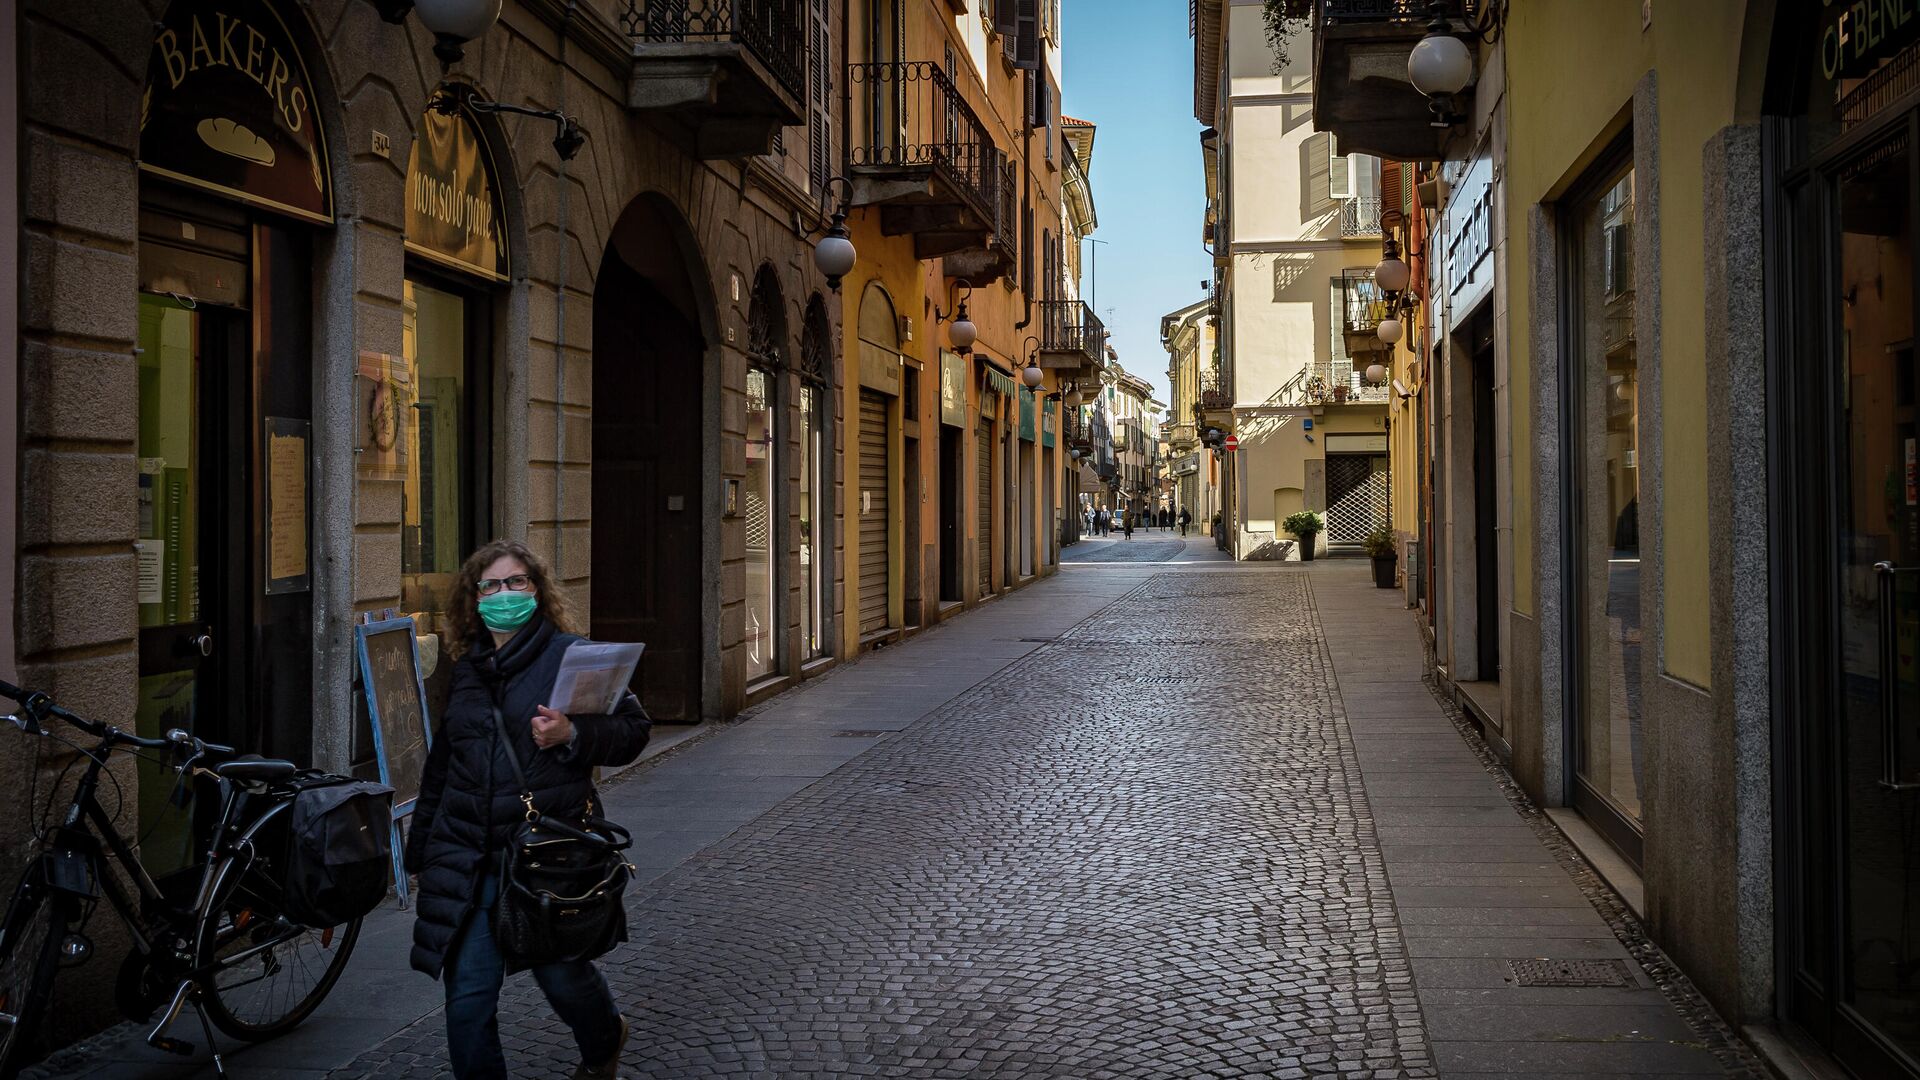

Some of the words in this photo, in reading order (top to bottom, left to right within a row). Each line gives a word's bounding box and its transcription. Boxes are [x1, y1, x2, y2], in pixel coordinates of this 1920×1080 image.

[153, 11, 308, 133] BAKERS
[1822, 10, 1849, 80] OF
[413, 170, 436, 218] non
[439, 169, 464, 228] solo
[465, 193, 493, 250] pane
